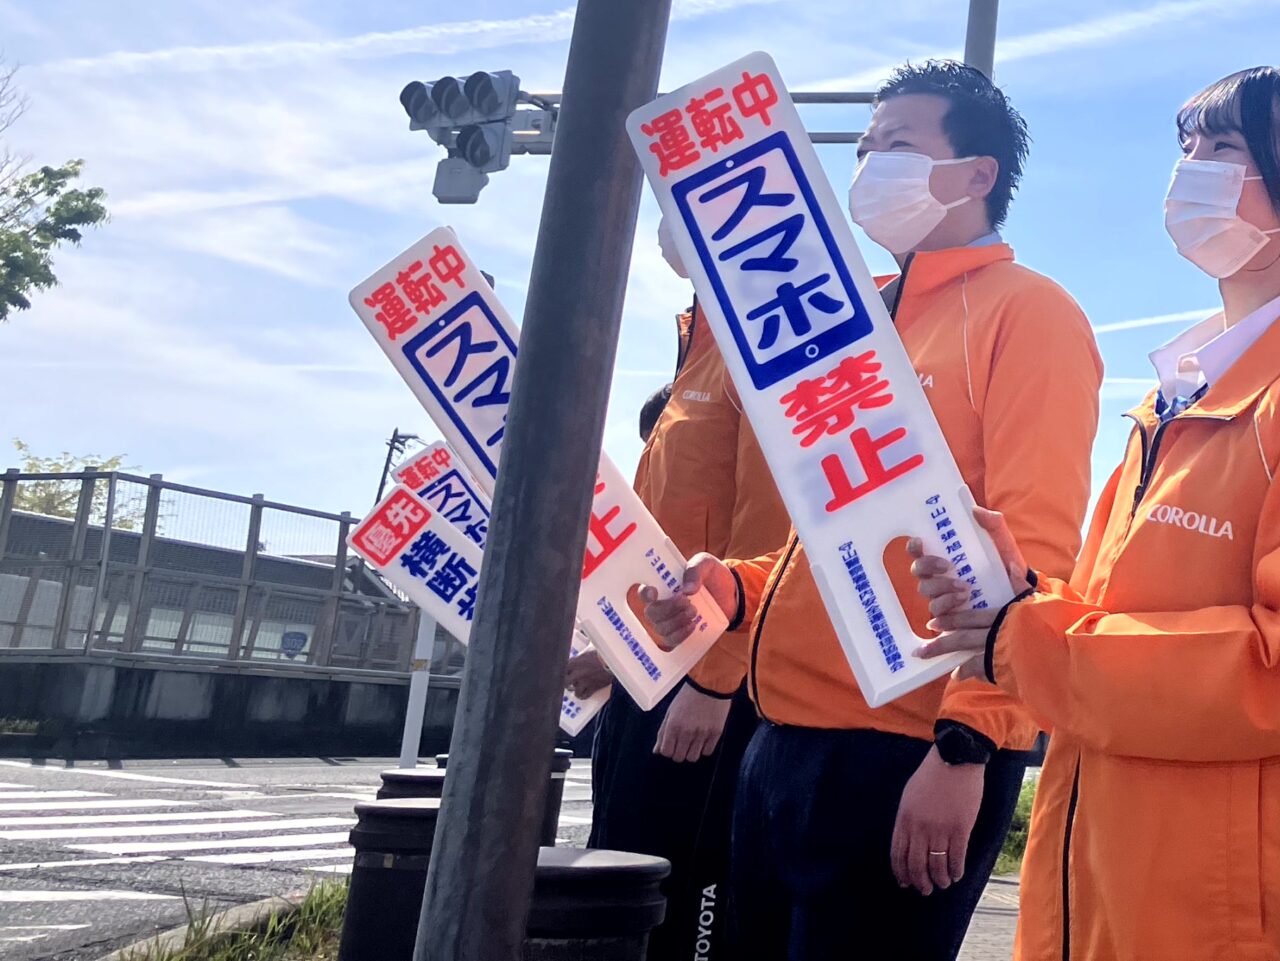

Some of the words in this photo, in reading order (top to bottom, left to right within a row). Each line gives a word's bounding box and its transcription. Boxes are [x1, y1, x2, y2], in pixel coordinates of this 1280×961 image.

[641, 71, 779, 177] 運転中
[364, 245, 466, 341] 運転中
[698, 165, 845, 351] スマホ
[425, 321, 510, 447] スマ
[779, 349, 925, 513] 禁止
[397, 447, 452, 490] 運転中
[360, 497, 425, 560] 優先
[581, 473, 638, 580] 止
[1147, 503, 1234, 541] COROLLA
[694, 883, 717, 961] TOYOTA
